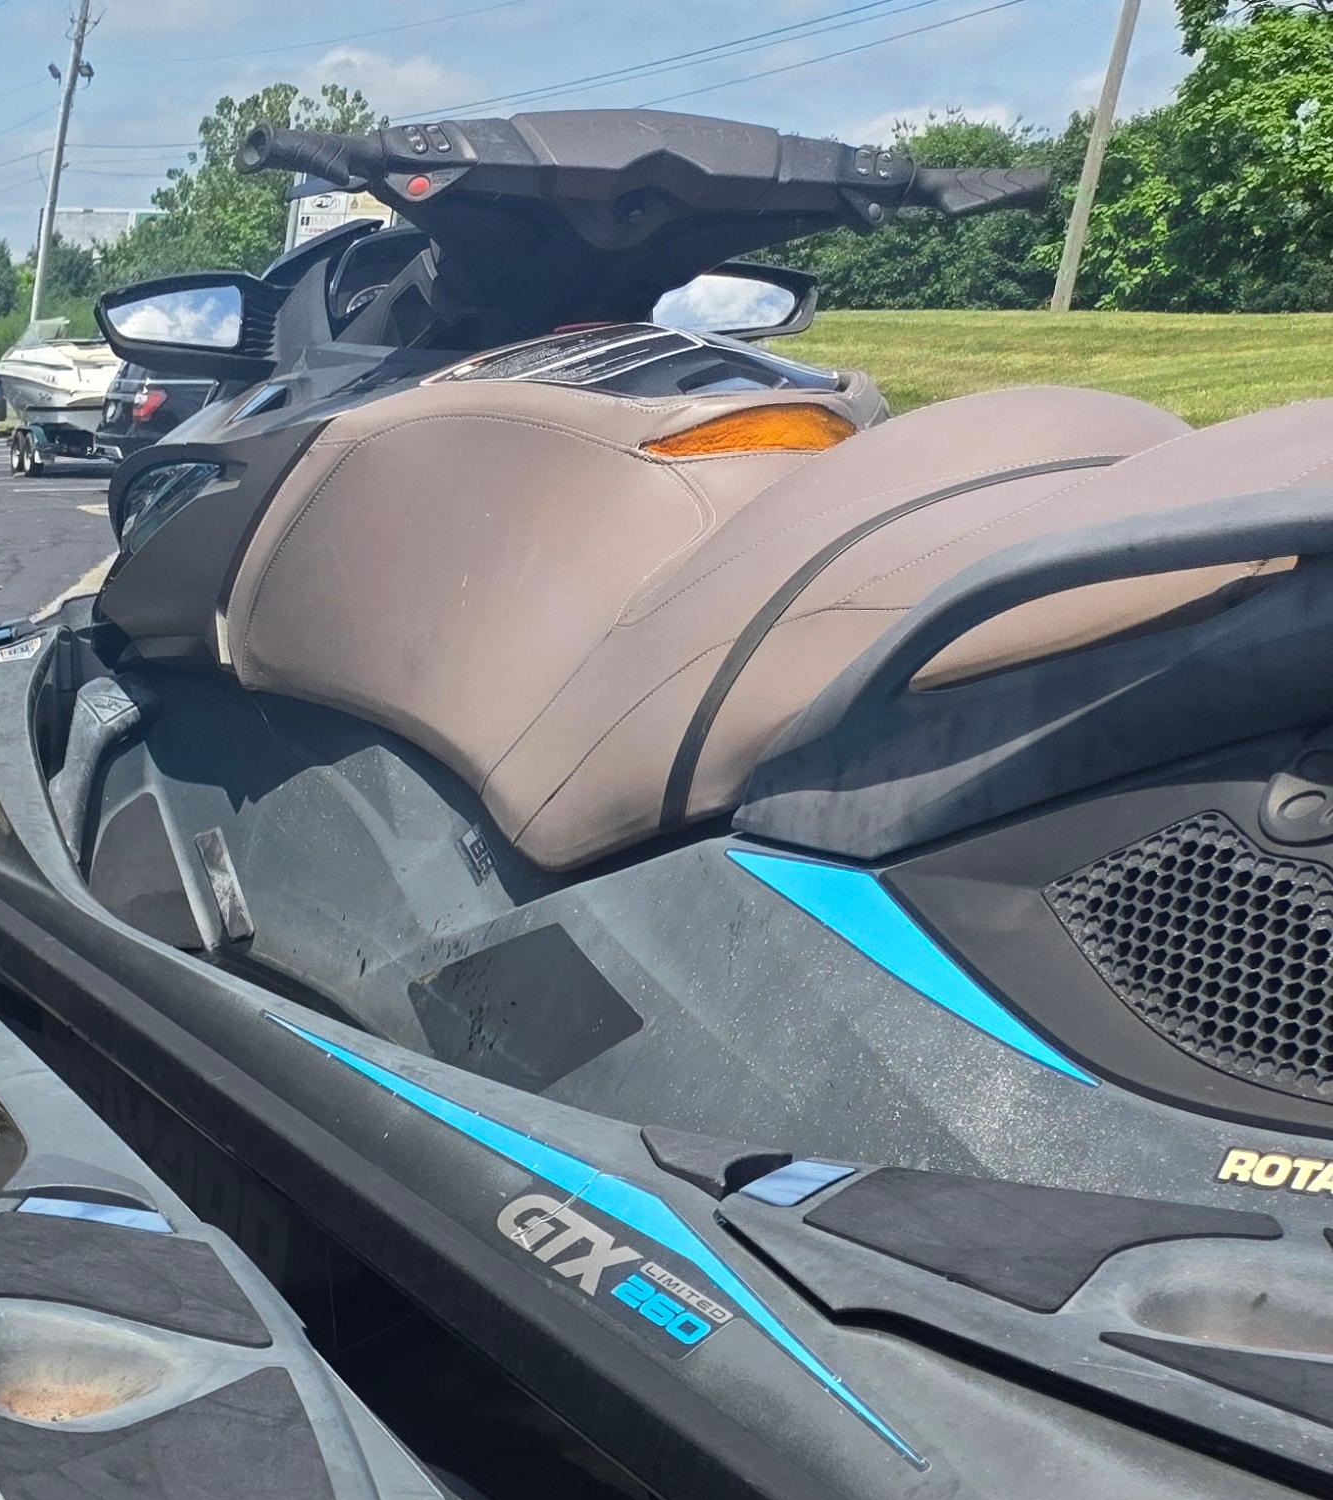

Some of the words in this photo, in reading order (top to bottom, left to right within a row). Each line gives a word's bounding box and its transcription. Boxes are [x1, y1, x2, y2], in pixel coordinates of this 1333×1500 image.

[497, 1194, 644, 1296] GTX
[610, 1273, 711, 1344] 260
[644, 1264, 727, 1320] LIMITED
